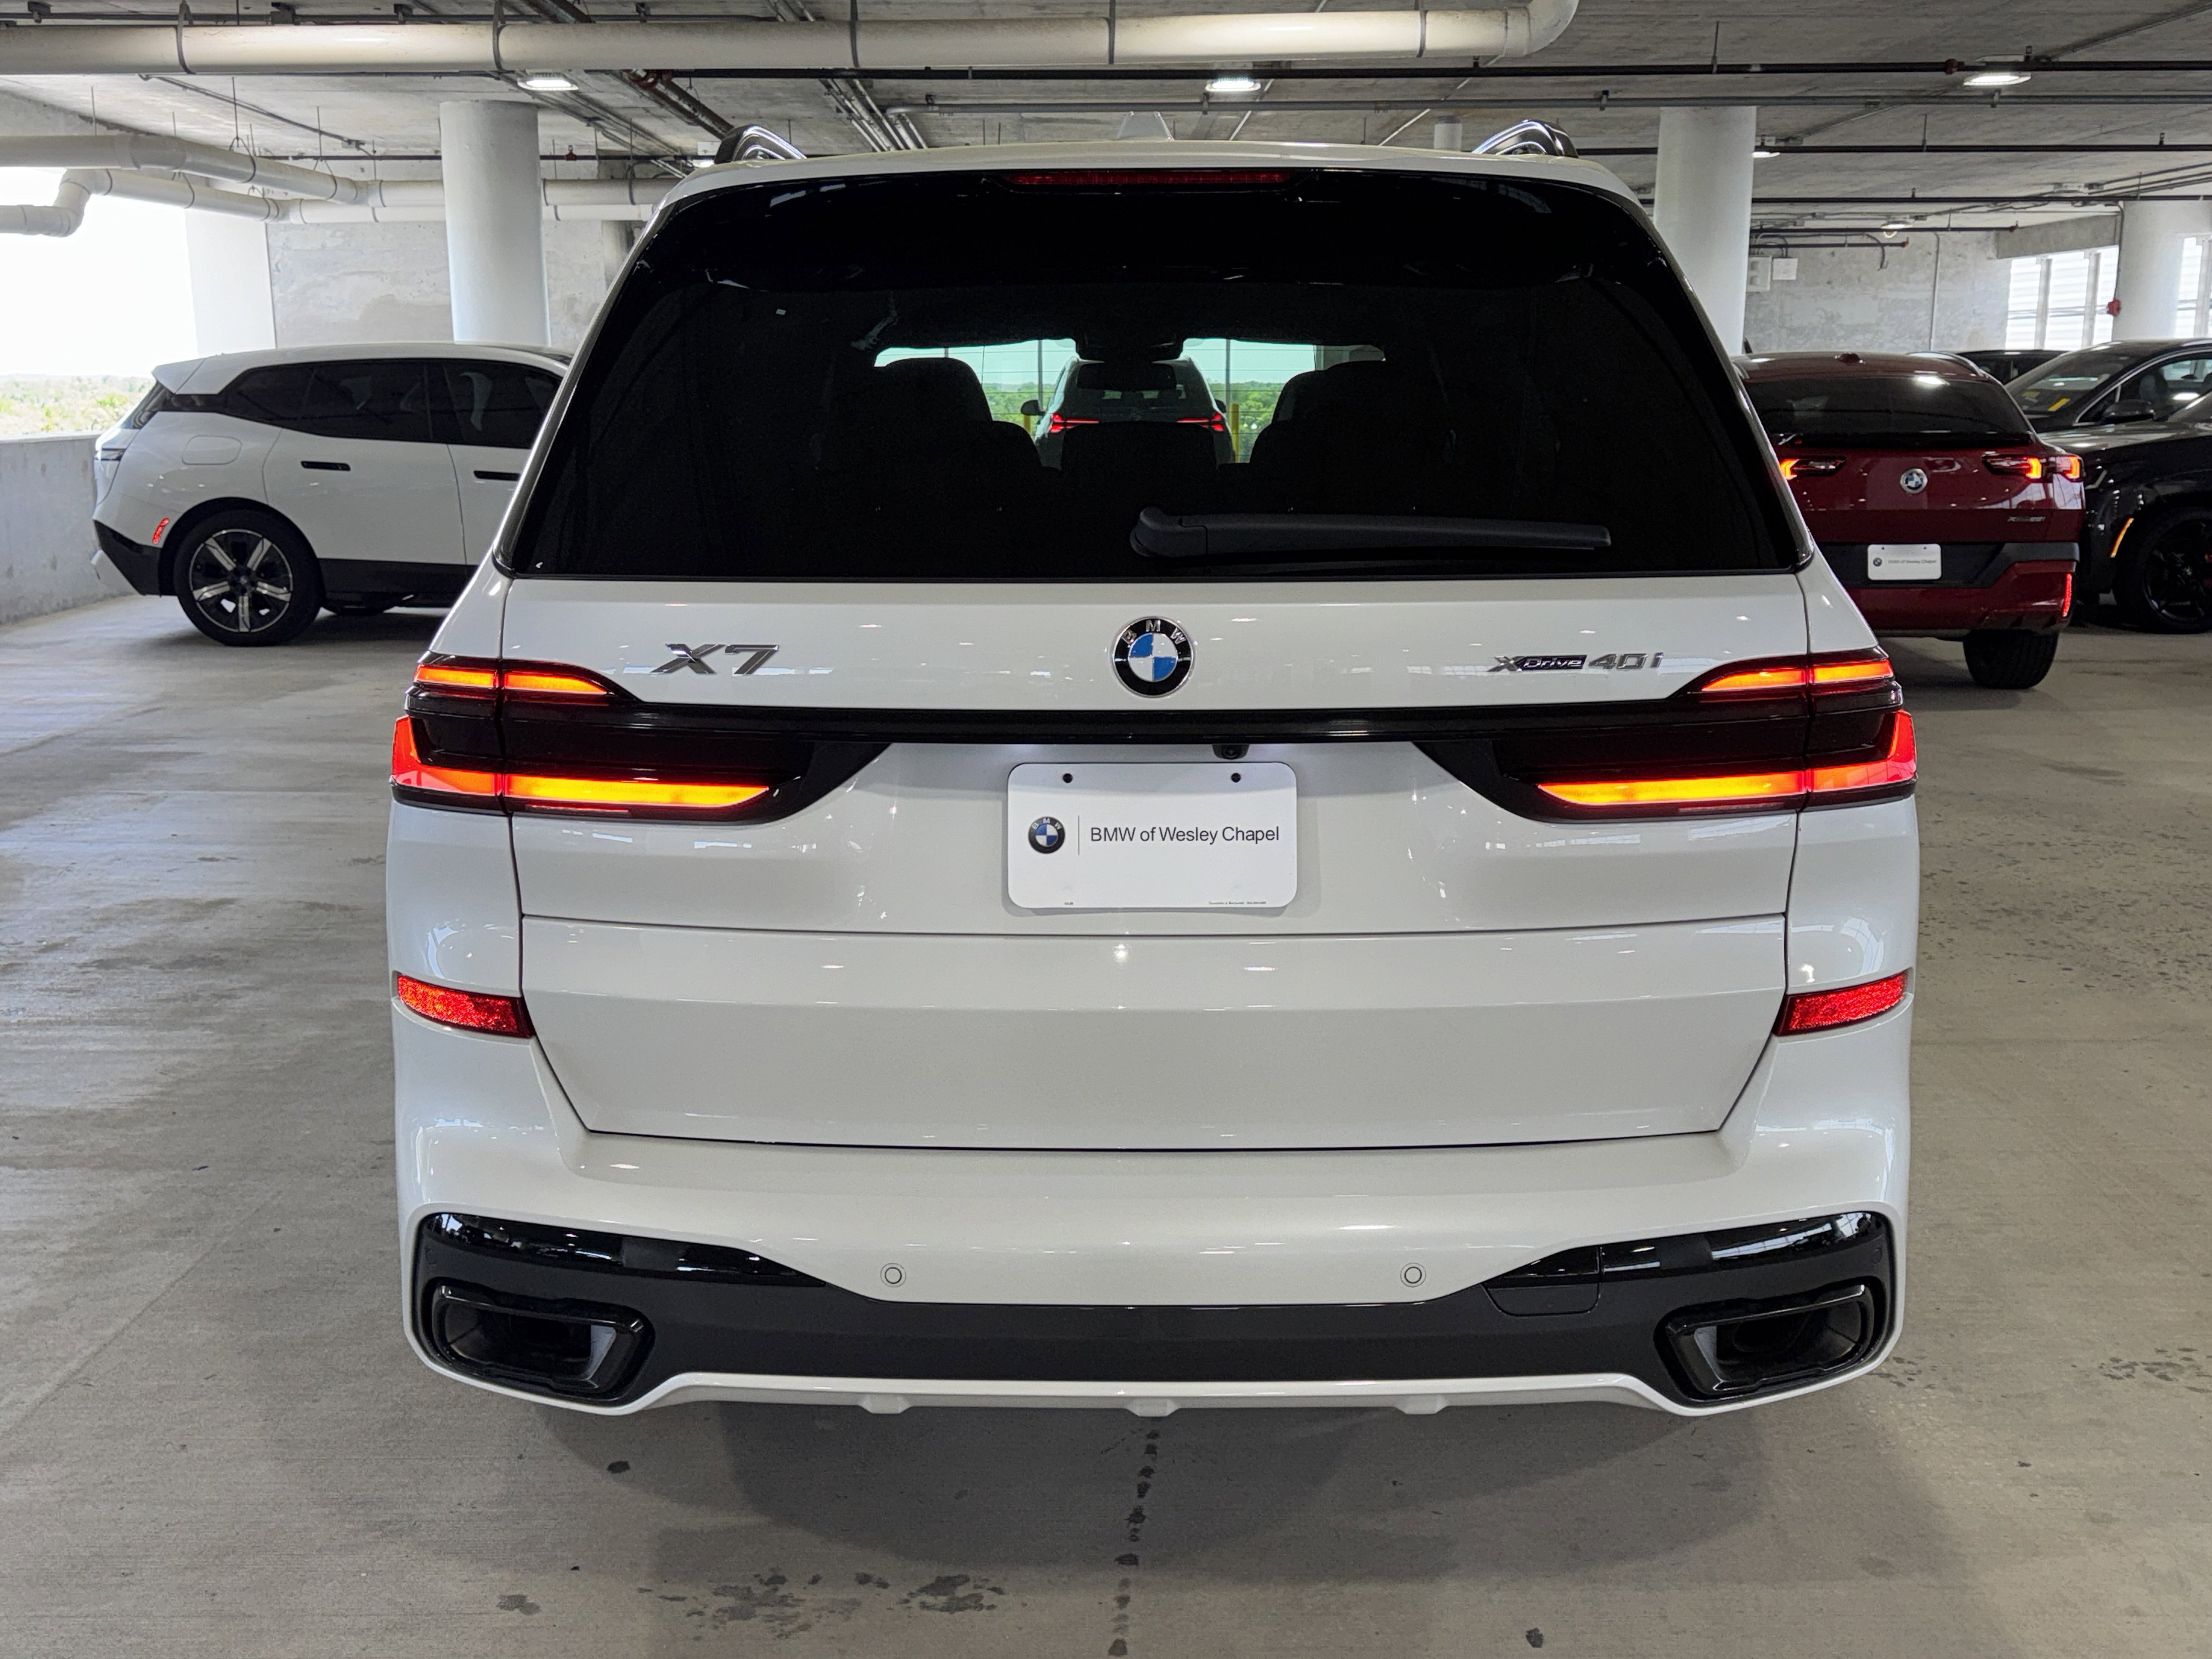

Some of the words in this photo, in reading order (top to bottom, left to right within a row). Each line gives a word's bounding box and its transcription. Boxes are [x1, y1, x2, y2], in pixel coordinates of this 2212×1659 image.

[1121, 619, 1186, 647] BMW
[650, 644, 780, 675] X7
[1091, 827, 1136, 842] BMW
[1139, 827, 1156, 842] of
[1159, 827, 1218, 845] Wesley
[1222, 826, 1279, 844] Chapel
